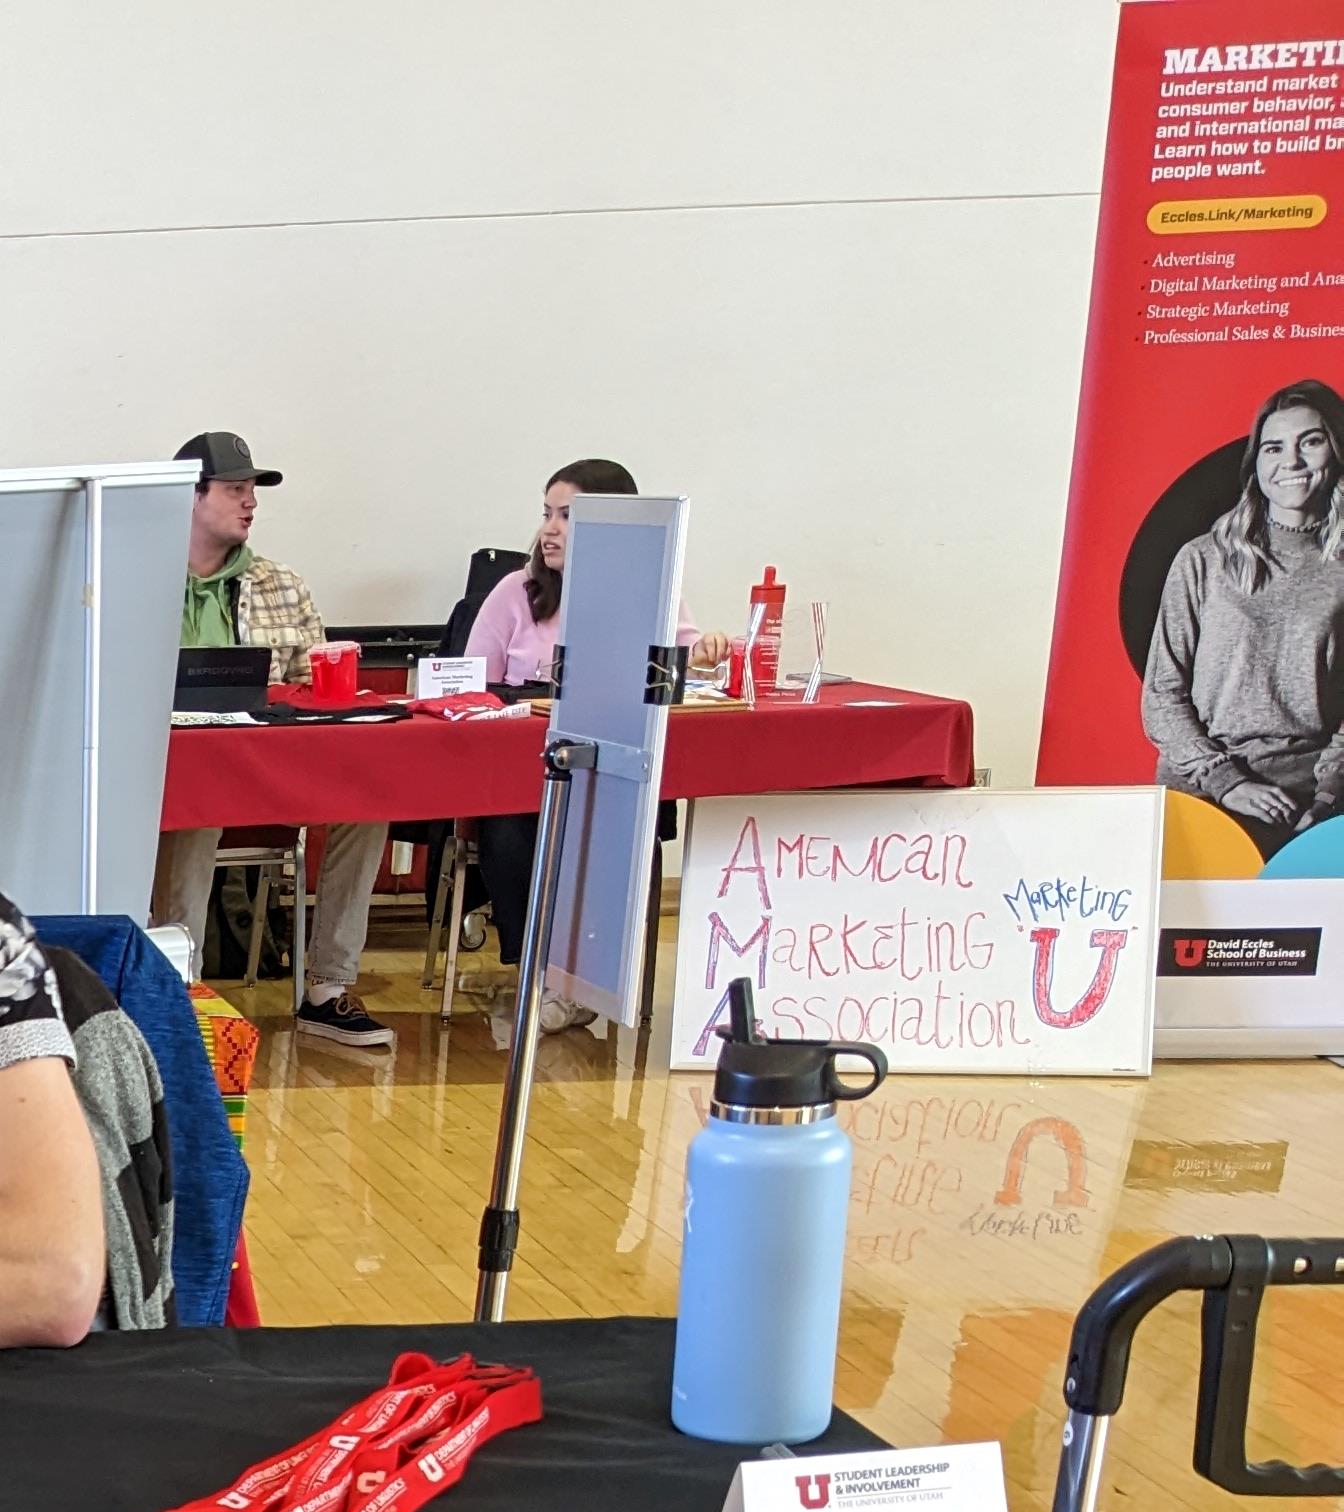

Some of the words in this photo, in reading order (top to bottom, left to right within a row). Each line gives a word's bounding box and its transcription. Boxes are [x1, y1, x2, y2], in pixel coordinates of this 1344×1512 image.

[1161, 76, 1268, 97] Understand
[1272, 73, 1338, 92] market
[1158, 99, 1248, 118] consumer
[1253, 94, 1335, 113] behavior,
[1156, 119, 1189, 138] and
[1194, 116, 1310, 136] international
[1154, 144, 1206, 159] Learn
[1211, 141, 1248, 156] how
[1253, 139, 1271, 154] to
[1276, 135, 1320, 153] build
[1151, 162, 1212, 182] people
[1217, 160, 1266, 176] want.
[1161, 206, 1313, 224] Eccles.Link/Marketing
[1152, 251, 1236, 268] Advertising
[1150, 276, 1198, 296] Digital
[1202, 274, 1277, 292] Marketing
[1280, 272, 1309, 287] and
[1147, 302, 1209, 321] Strategic
[1213, 300, 1289, 317] Marketing
[1144, 327, 1228, 344] Professional
[1232, 326, 1269, 341] Sales
[1273, 326, 1285, 339] &
[1207, 949, 1243, 958] School
[1245, 949, 1256, 958] of
[1258, 949, 1306, 958] Business
[1208, 939, 1240, 949] David
[1242, 939, 1274, 949] Eccles
[795, 1473, 831, 1510] U
[834, 1468, 883, 1482] STUDENT
[885, 1462, 950, 1478] LEADERSHIP
[835, 1485, 843, 1495] &
[845, 1478, 920, 1494] INVOLVEMENT
[855, 1496, 905, 1508] UNIVERSITY
[906, 1495, 918, 1503] OF
[919, 1492, 944, 1501] UTAH
